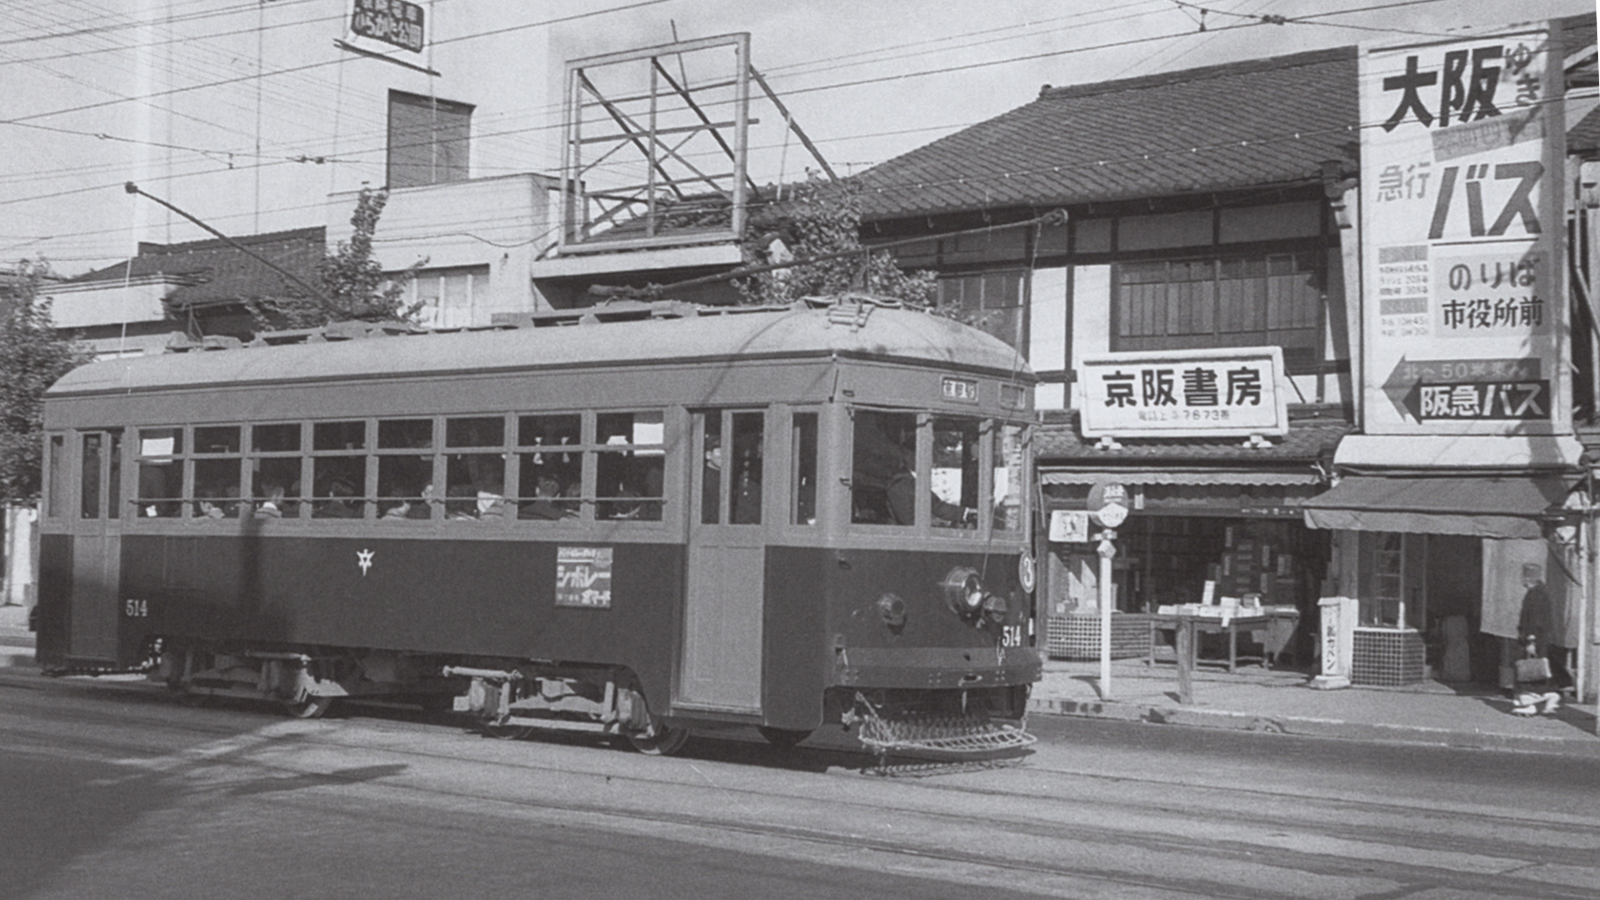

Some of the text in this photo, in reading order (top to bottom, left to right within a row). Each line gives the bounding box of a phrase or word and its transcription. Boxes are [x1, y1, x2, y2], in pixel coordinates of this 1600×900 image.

[1380, 42, 1541, 133] 大阪 ゆき
[1376, 160, 1545, 239] 急行 バス
[1449, 258, 1540, 291] のりば
[1441, 295, 1544, 330] 市役所前
[1102, 366, 1262, 408] 京阪書房
[1420, 382, 1545, 417] 阪急バス
[1023, 557, 1033, 588] 3
[125, 598, 148, 617] 514
[1002, 624, 1021, 648] 514
